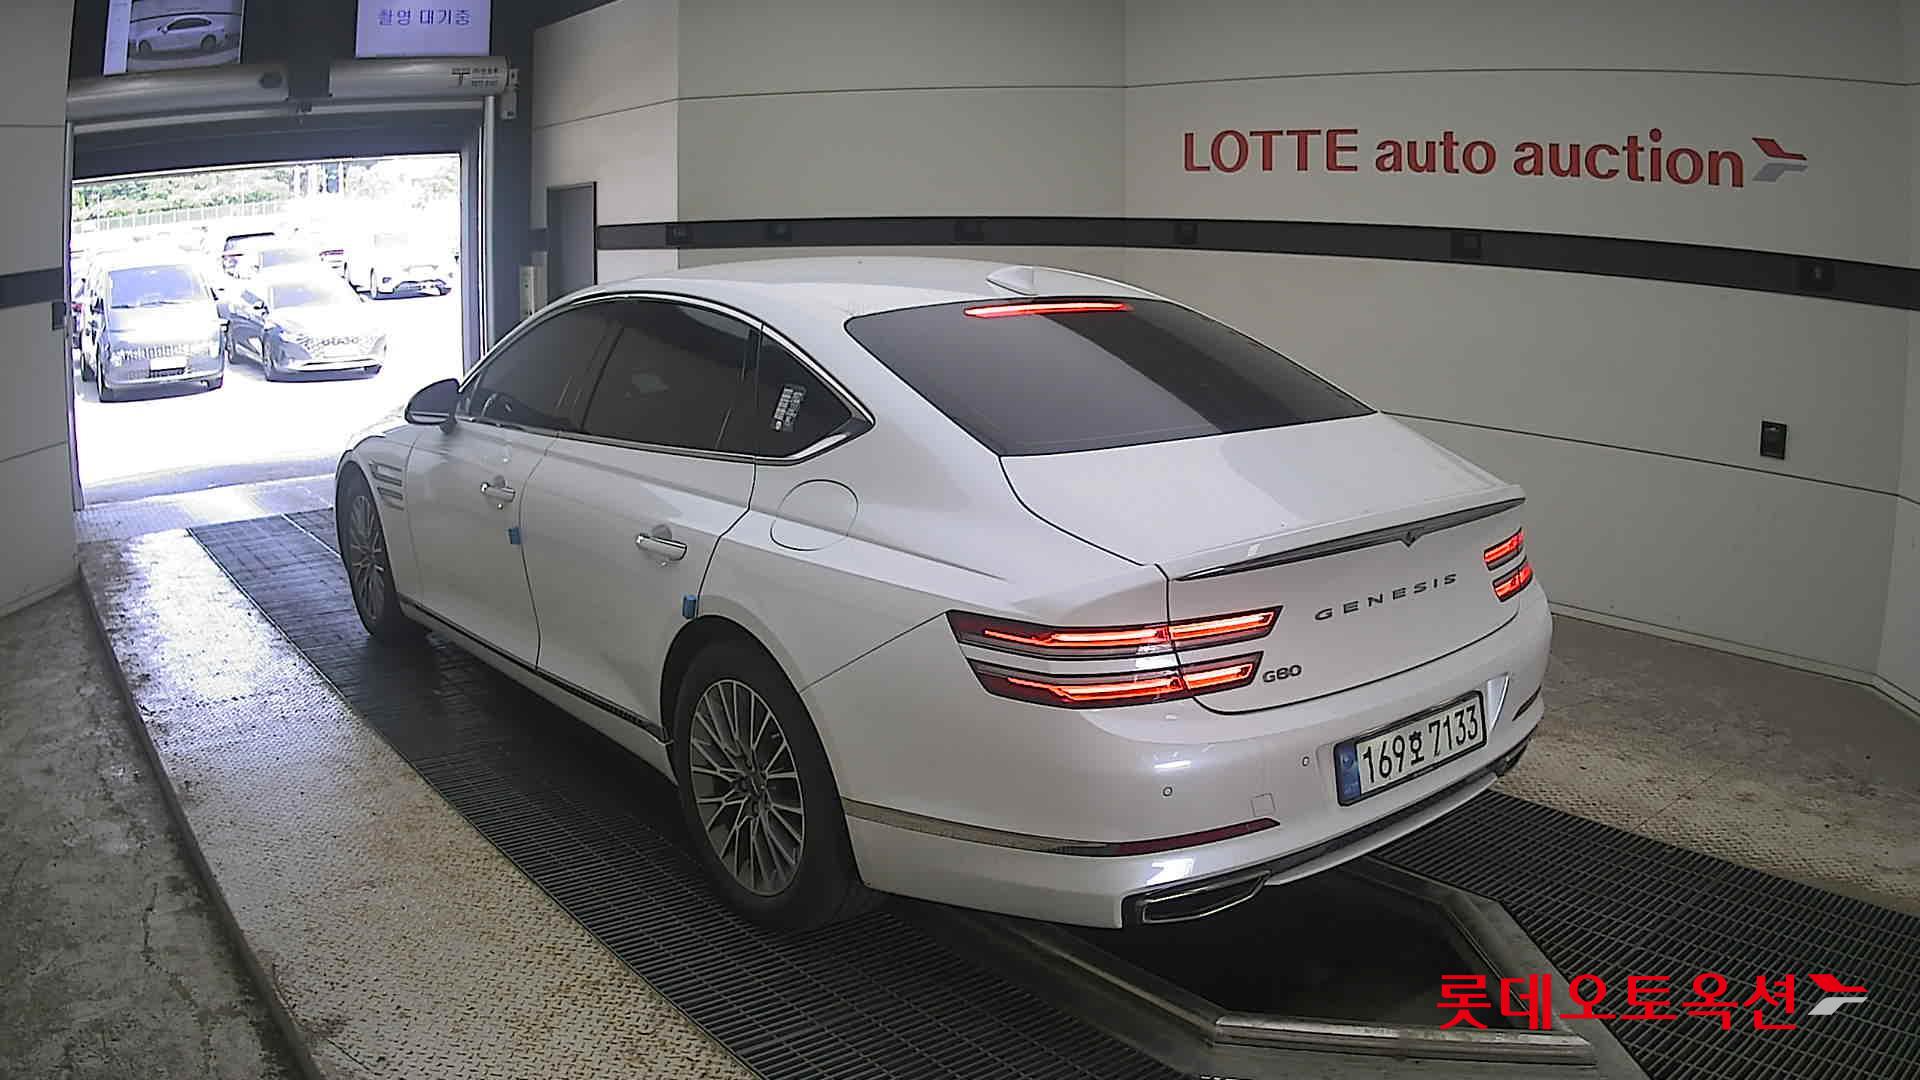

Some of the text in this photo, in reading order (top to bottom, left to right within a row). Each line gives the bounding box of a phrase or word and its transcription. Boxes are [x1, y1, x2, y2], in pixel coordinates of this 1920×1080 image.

[419, 8, 471, 26] 대기중
[1184, 128, 1744, 188] LOTTE auto auction
[1314, 573, 1457, 621] GENESIS
[1262, 664, 1302, 683] G80
[1363, 705, 1479, 784] 169호 7133
